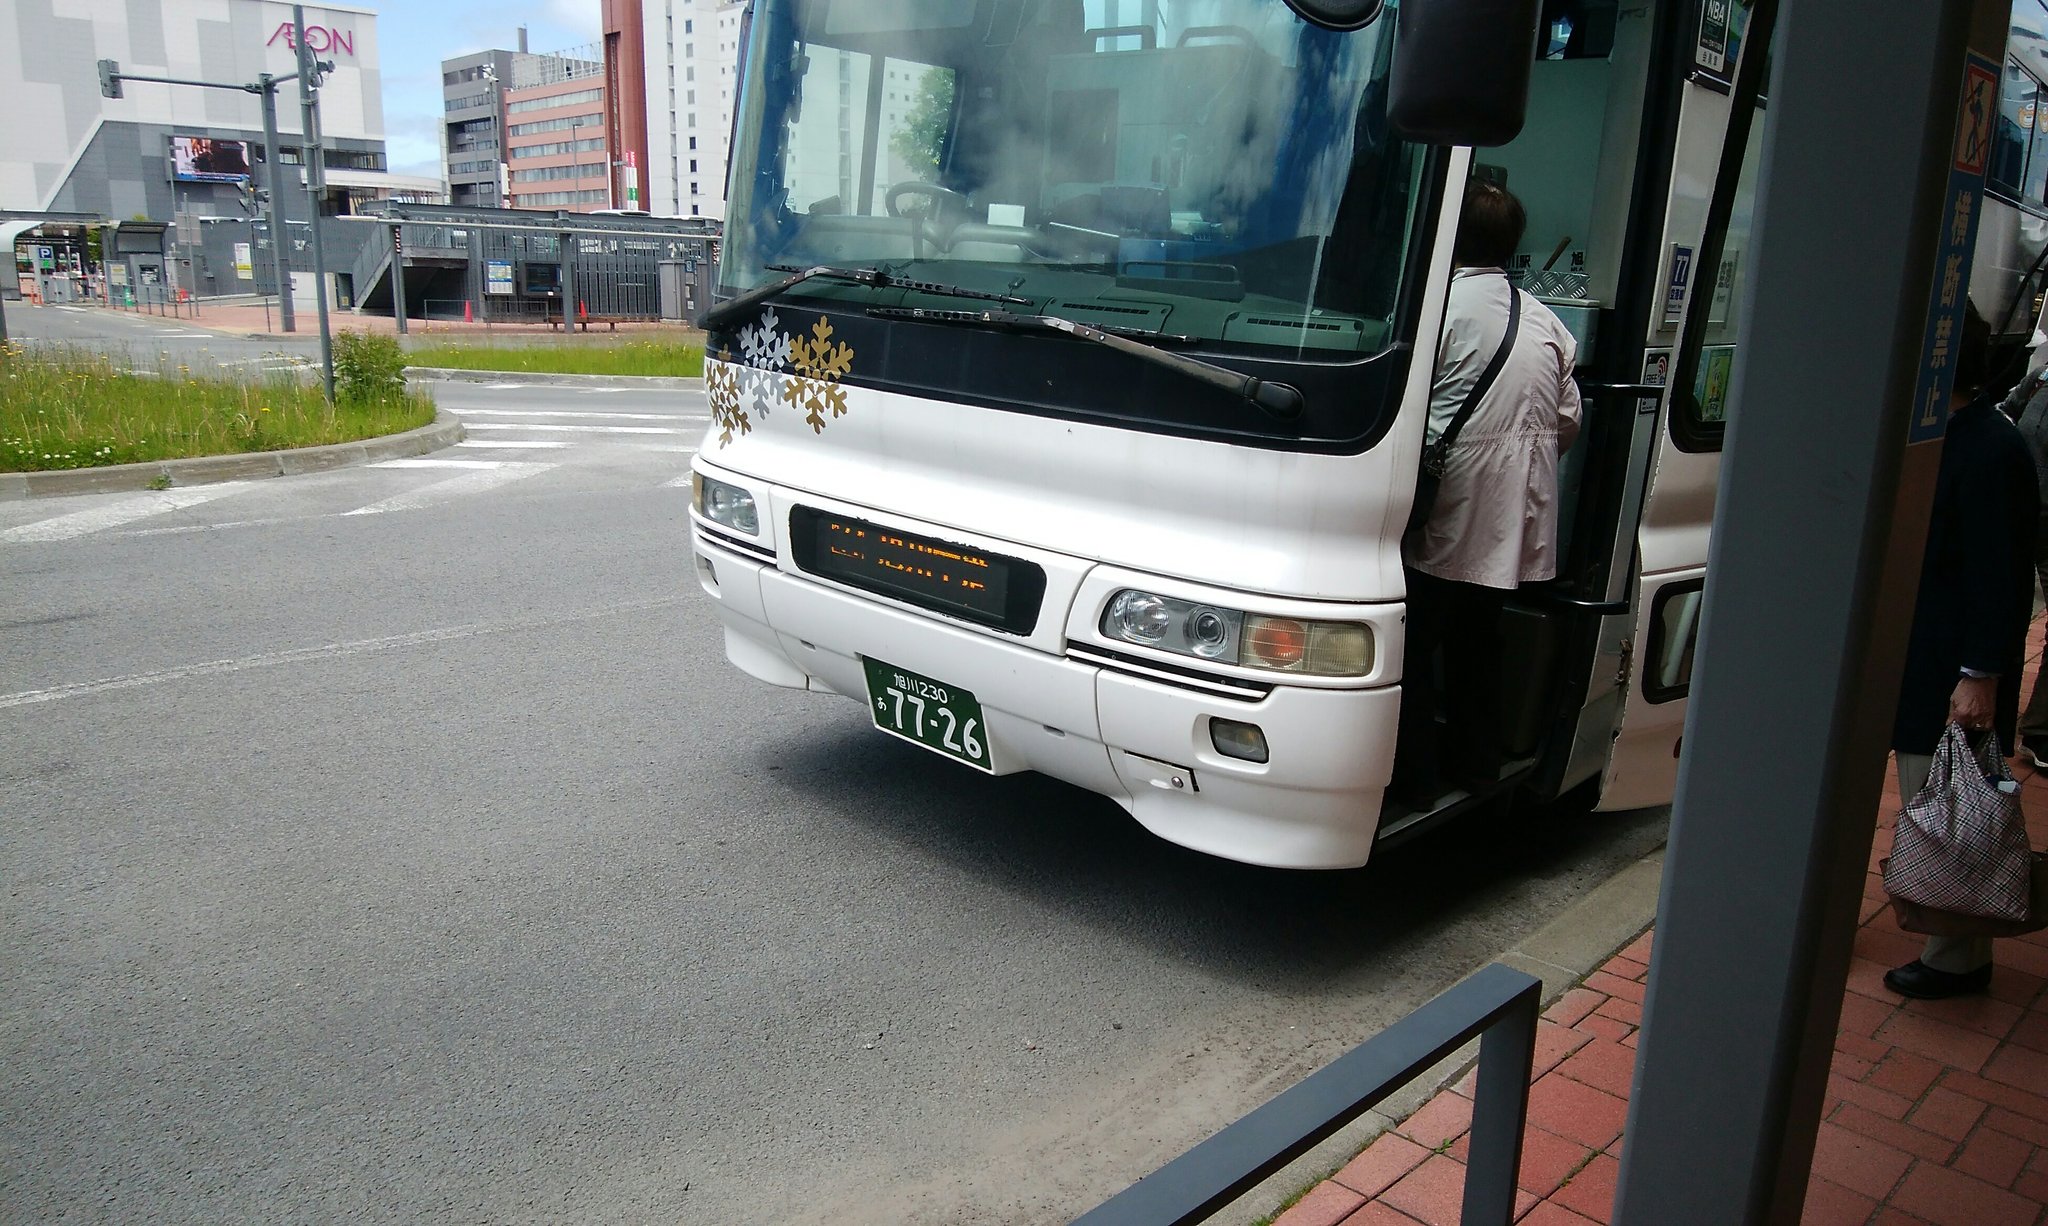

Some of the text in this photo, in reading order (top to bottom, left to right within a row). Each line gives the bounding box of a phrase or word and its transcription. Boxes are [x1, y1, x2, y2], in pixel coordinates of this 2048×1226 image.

[41, 248, 50, 258] P
[1674, 255, 1690, 283] 77
[1920, 189, 1972, 427] 横断禁止
[886, 687, 982, 759] 77-26
